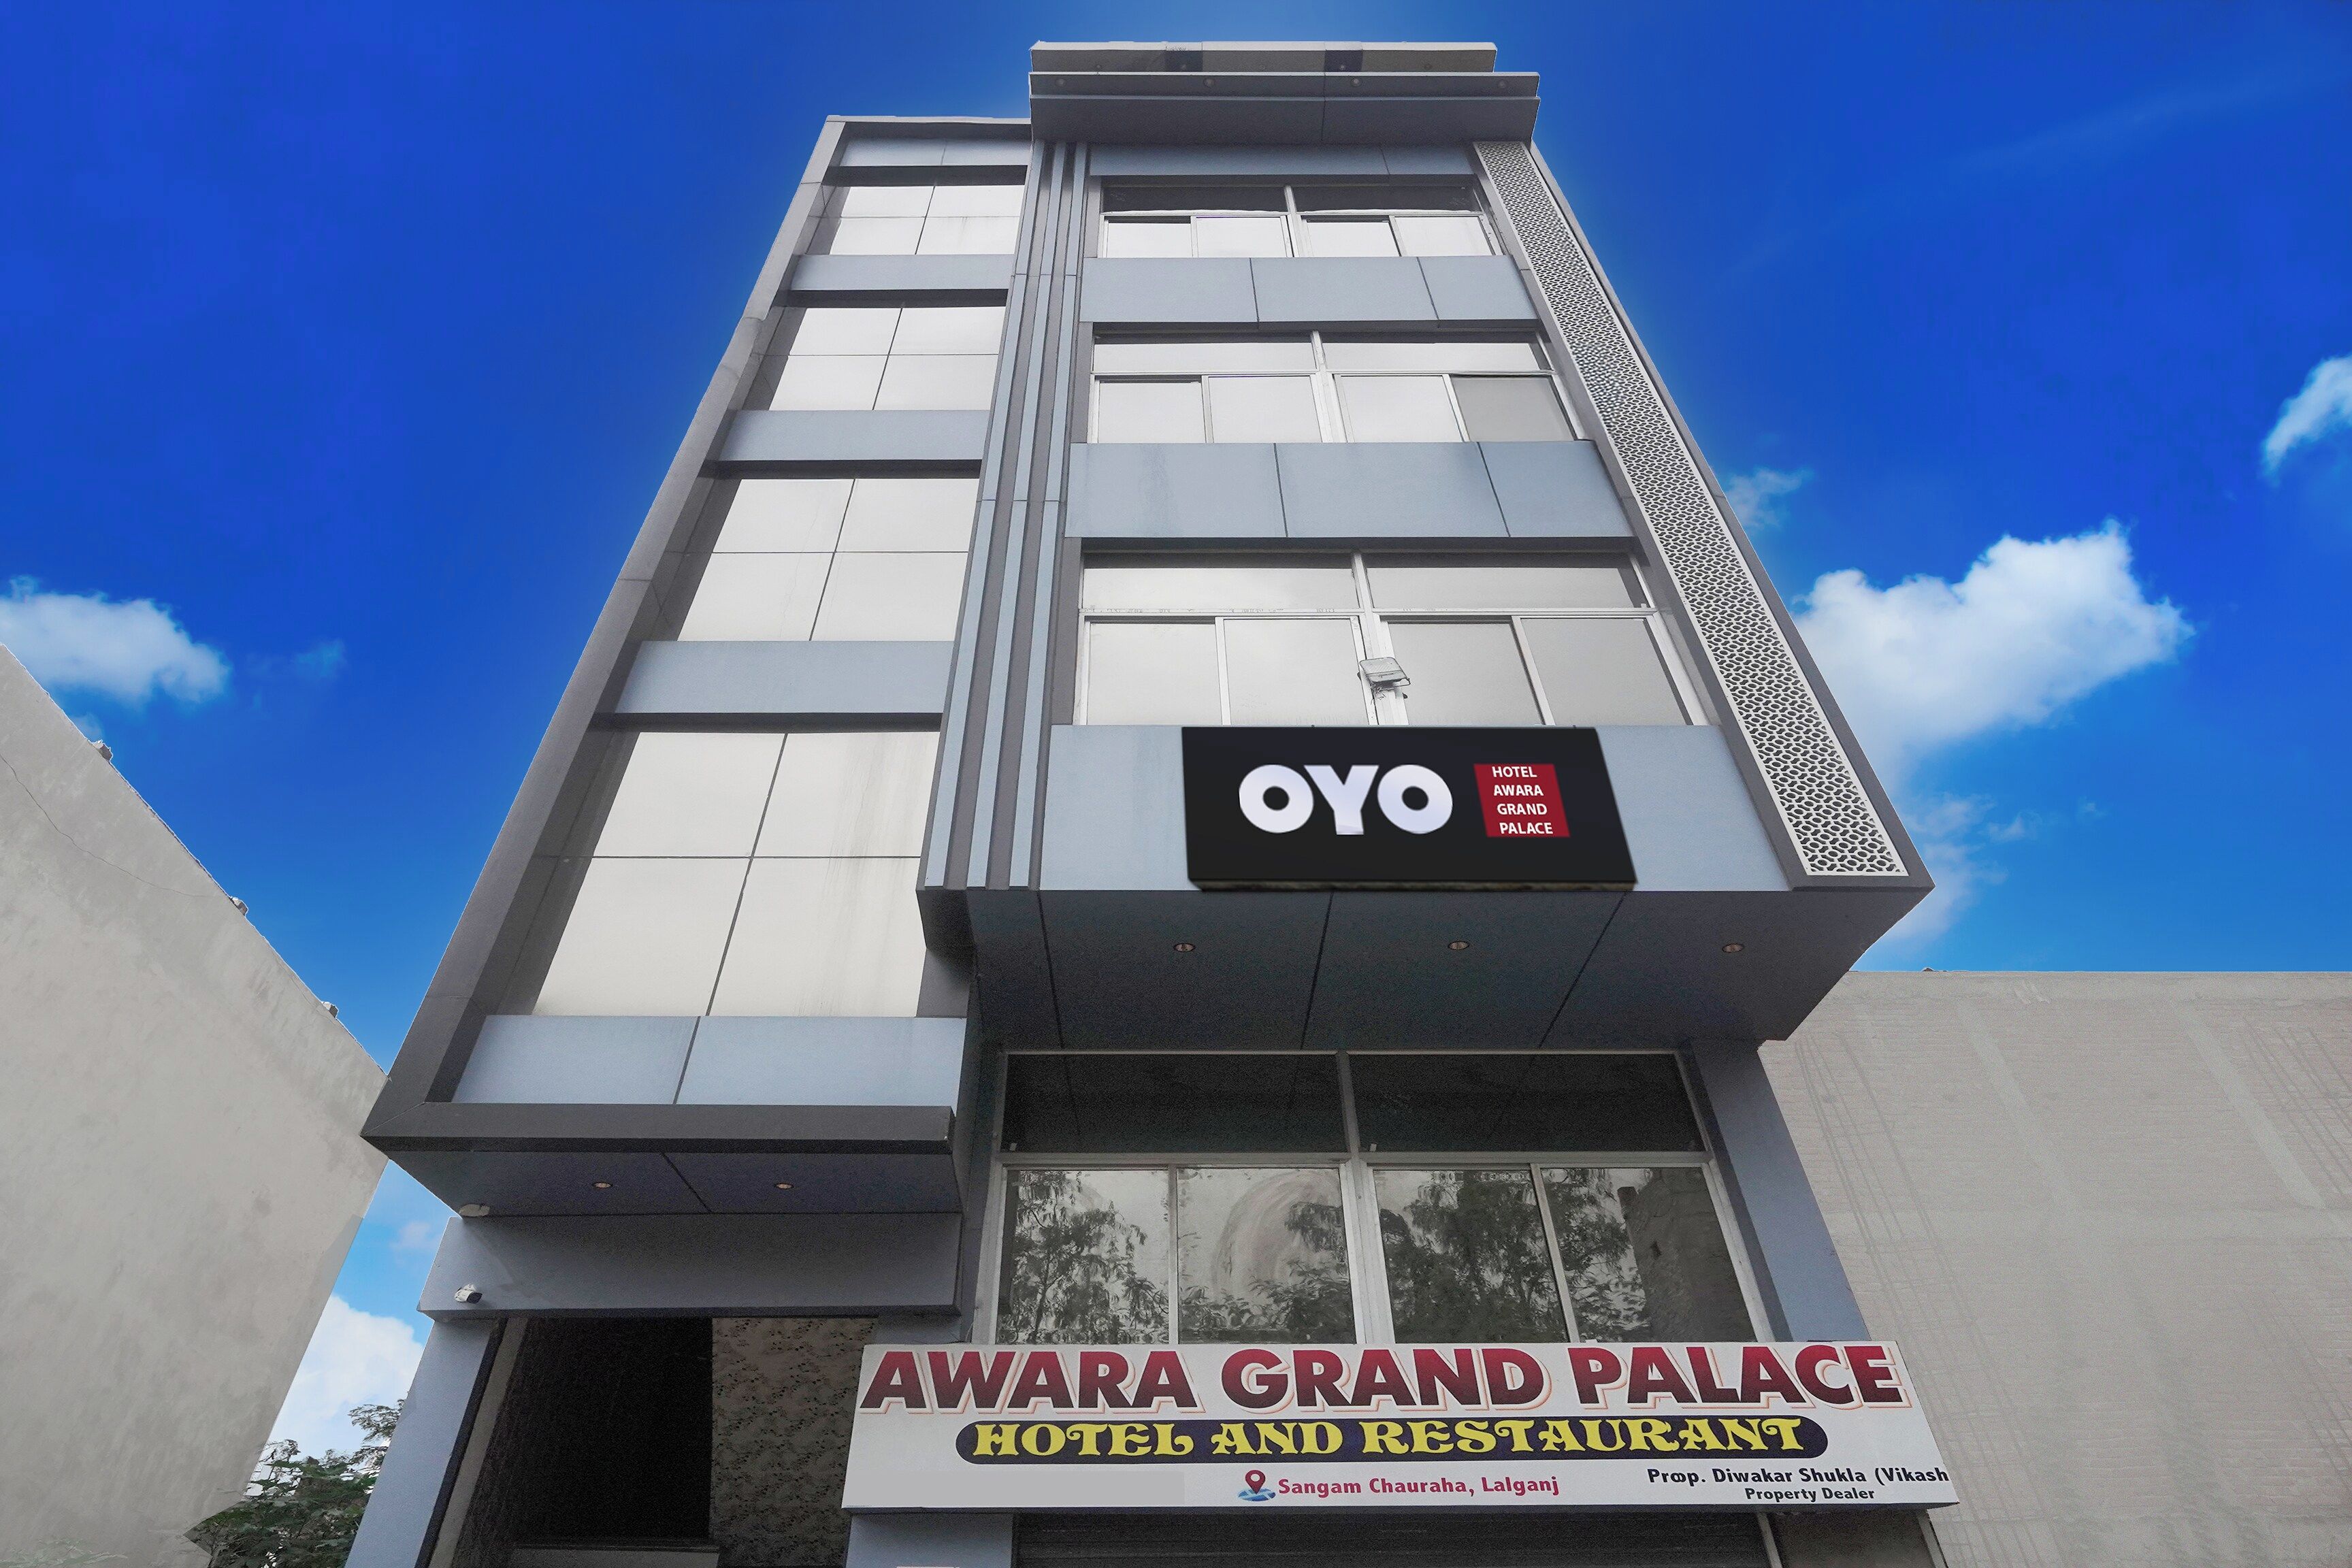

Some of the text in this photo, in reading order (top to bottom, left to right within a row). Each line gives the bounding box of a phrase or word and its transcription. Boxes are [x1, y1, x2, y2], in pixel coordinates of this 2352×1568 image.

[1491, 766, 1538, 778] HOTEL
[1493, 784, 1544, 796] AWARA
[1239, 764, 1453, 835] OYO
[1497, 803, 1548, 815] GRAND
[1499, 822, 1554, 834] PALACE
[860, 1345, 1911, 1413] AWARA GRAND PALACE
[971, 1418, 1804, 1456] HOTEL AND RESTAURANT
[1712, 1468, 1793, 1483] Diwakar
[1798, 1468, 1867, 1482] Shukla
[1874, 1467, 1949, 1486] (Vikash
[1278, 1476, 1559, 1498] Sangam Chauraha, Lalganj
[1744, 1487, 1875, 1503] Property Dealer
